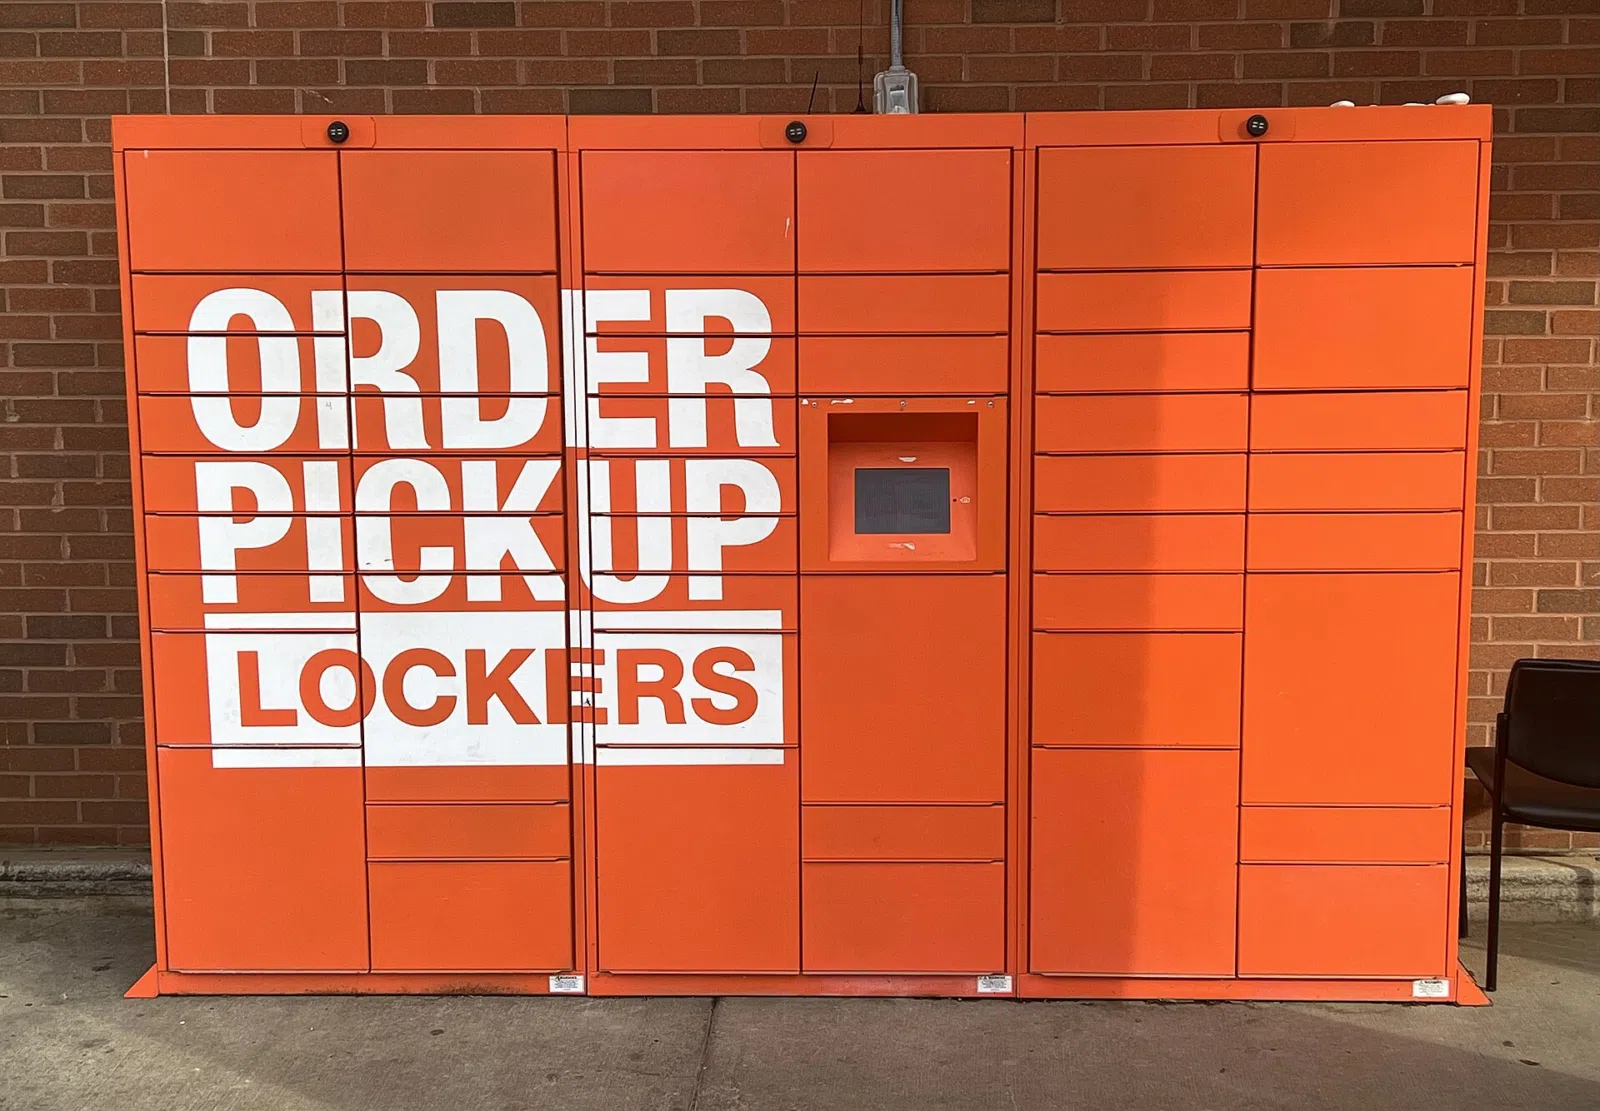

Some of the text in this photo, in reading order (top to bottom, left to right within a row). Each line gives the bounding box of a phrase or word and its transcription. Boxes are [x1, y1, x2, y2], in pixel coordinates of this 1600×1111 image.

[187, 287, 780, 452] ORDER
[195, 458, 782, 605] PICKUP
[237, 647, 759, 727] LOCKERS
